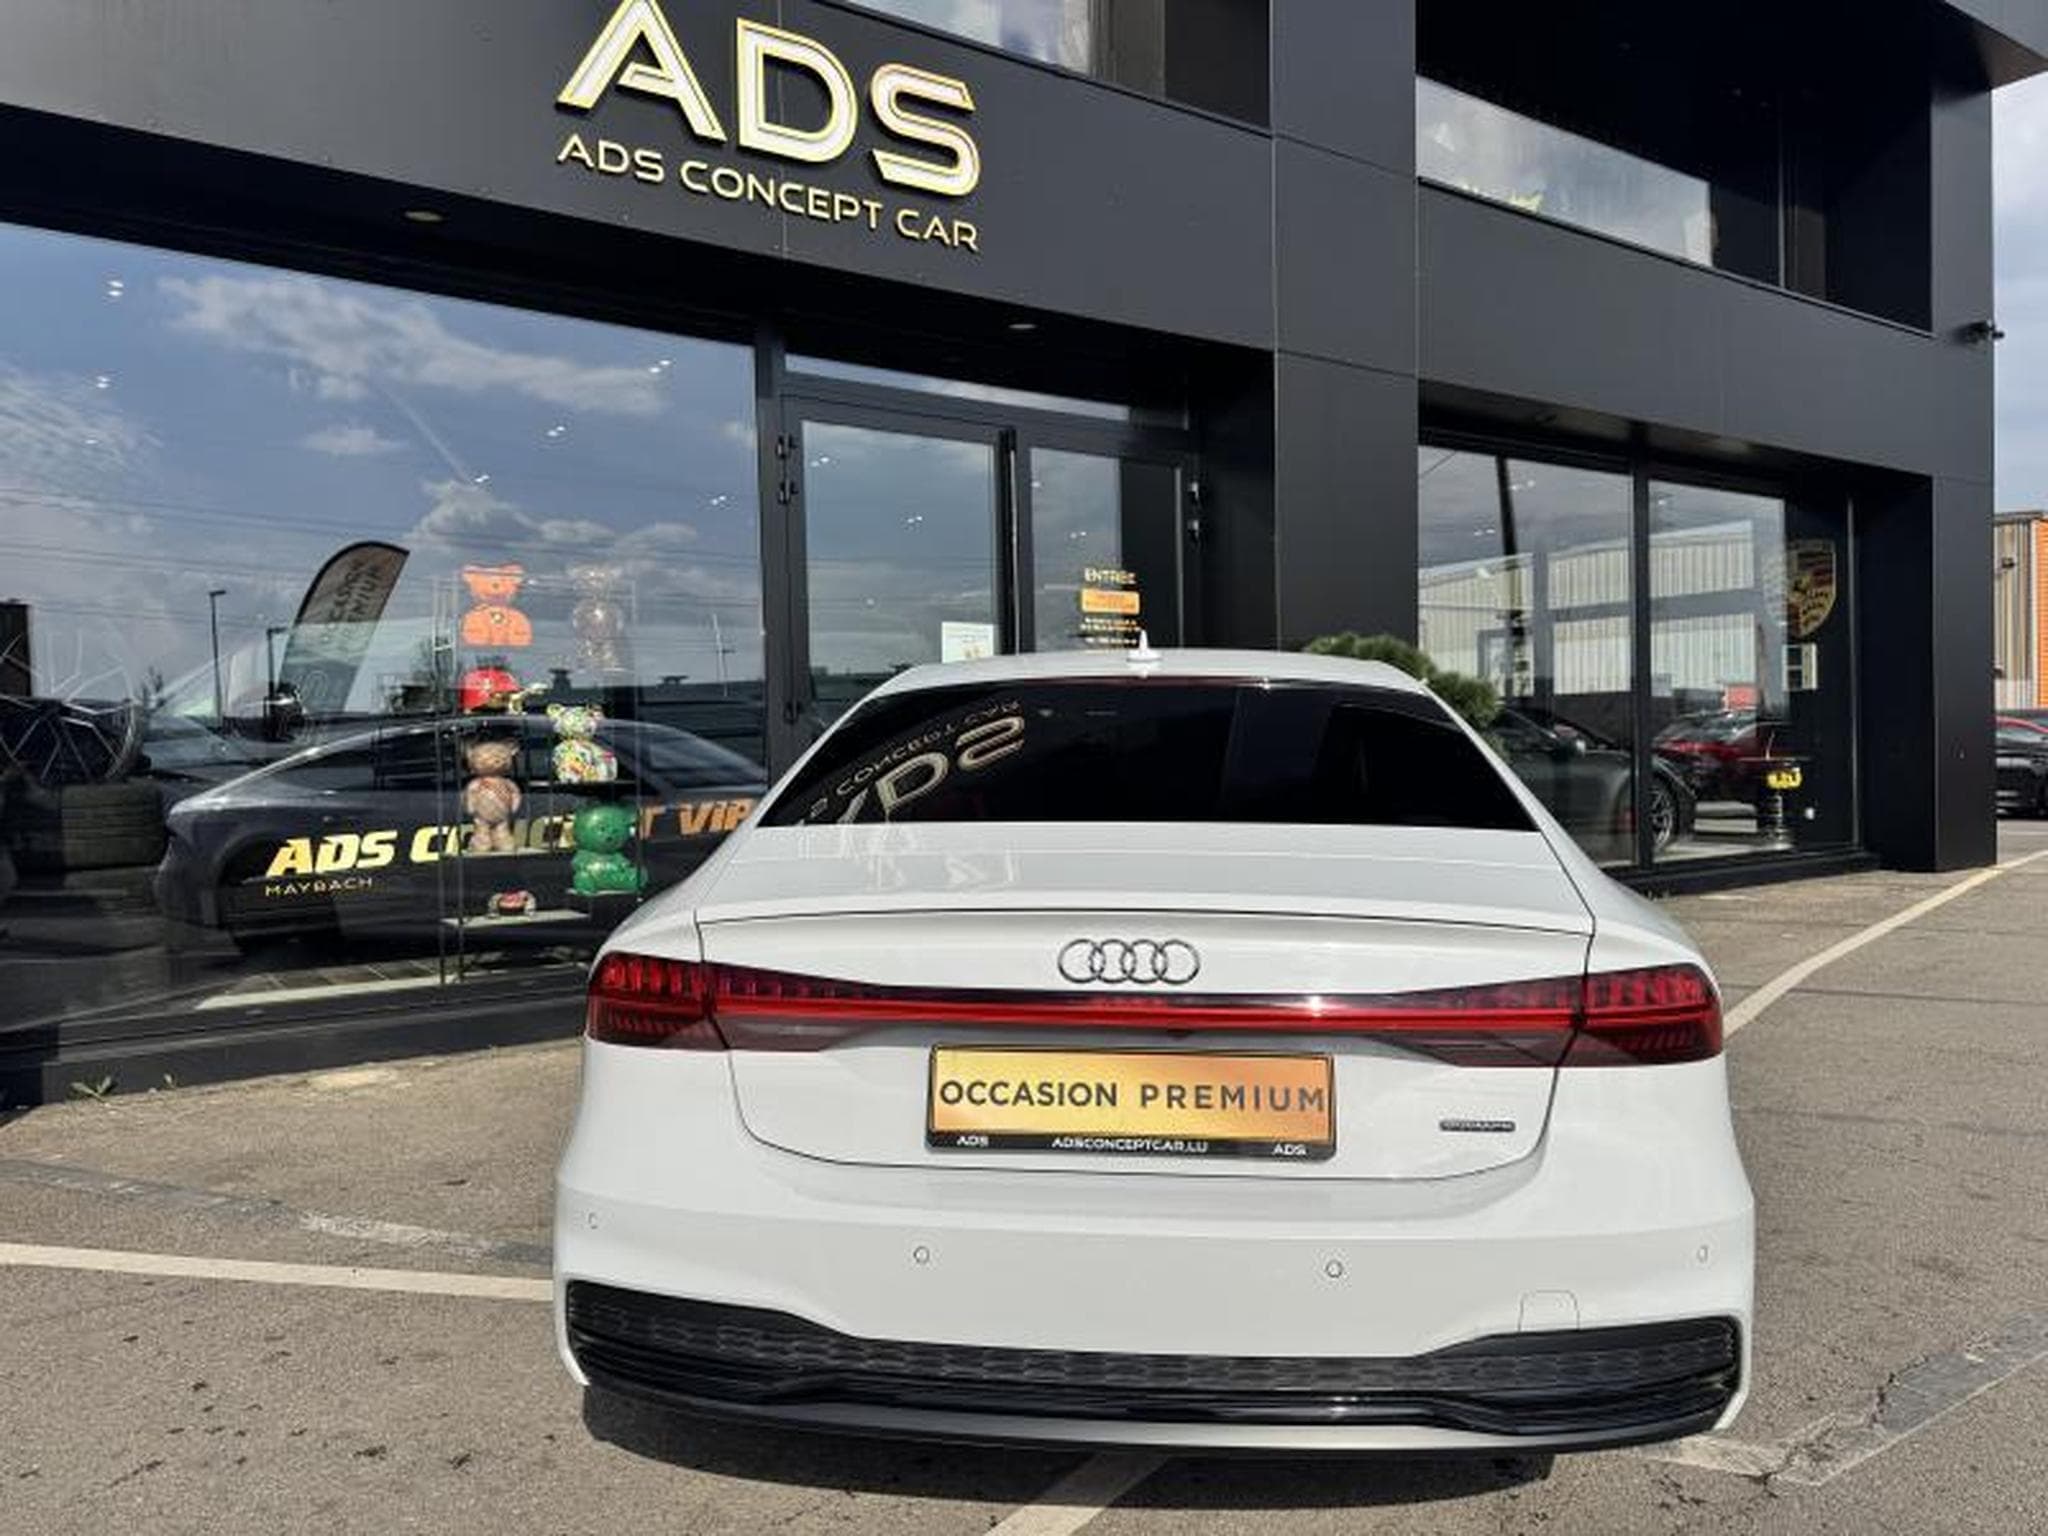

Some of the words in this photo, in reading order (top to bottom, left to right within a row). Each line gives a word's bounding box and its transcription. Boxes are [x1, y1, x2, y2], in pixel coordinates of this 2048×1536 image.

[556, 0, 981, 198] ADS
[557, 133, 666, 183] ADS
[681, 159, 883, 230] CONCEPT
[897, 208, 980, 251] CAR
[265, 829, 398, 878] ADS
[265, 876, 373, 897] MAYBACH
[939, 1080, 1118, 1107] OCCASION
[1141, 1084, 1326, 1113] PREMIUM
